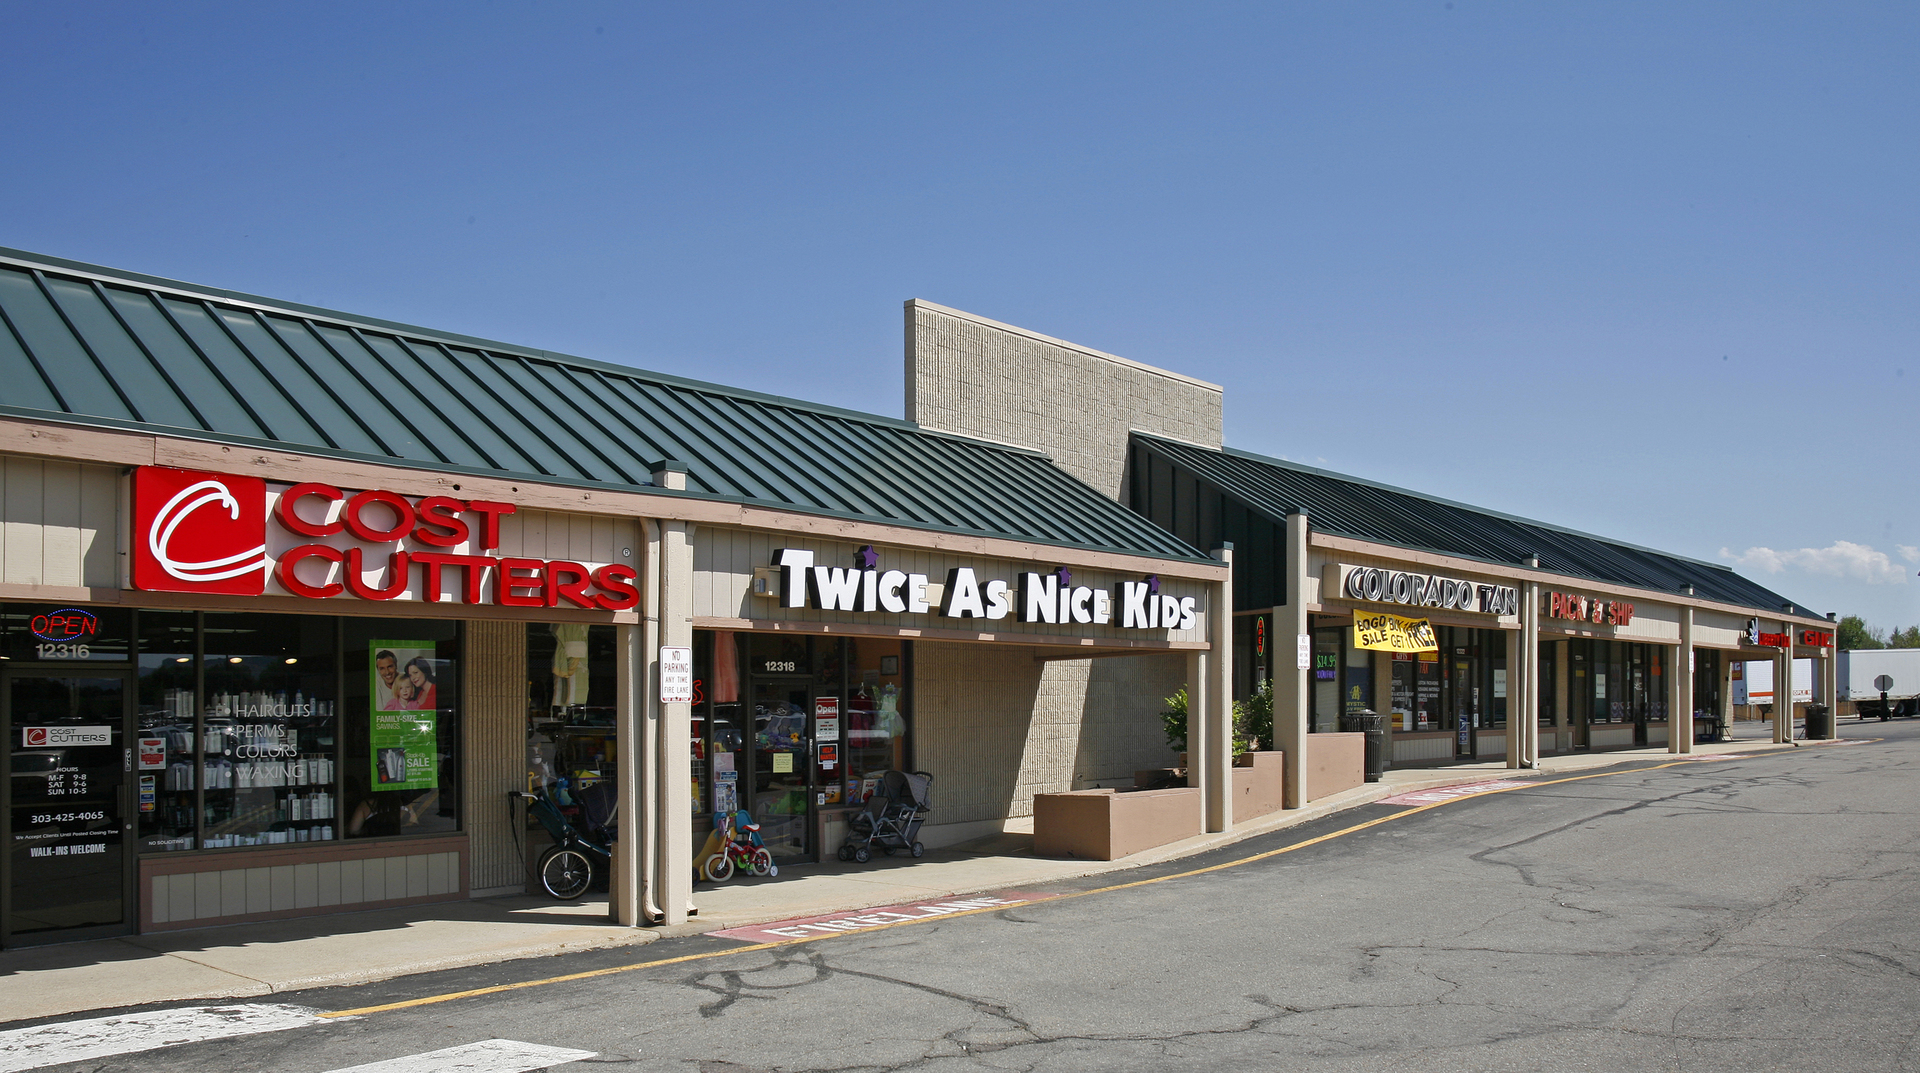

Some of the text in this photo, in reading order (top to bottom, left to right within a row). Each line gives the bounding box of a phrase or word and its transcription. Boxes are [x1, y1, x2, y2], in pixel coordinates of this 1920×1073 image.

[274, 482, 516, 550] COST
[274, 543, 640, 611] CUTTERS
[1346, 567, 1519, 615] COLORADO TAN
[1545, 590, 1635, 627] PACK & SHIP
[31, 615, 98, 635] OPEN
[1357, 615, 1386, 633] BOGO
[1361, 630, 1388, 647] SALE
[1390, 634, 1404, 648] GET
[1407, 622, 1436, 649] FREE
[1802, 630, 1834, 648] GNC
[35, 644, 90, 658] 12316
[671, 650, 681, 661] NO
[664, 662, 689, 674] PARKING
[765, 661, 796, 672] 12318
[664, 676, 688, 684] ANY TIME
[664, 686, 689, 694] FIRE LANE
[235, 704, 311, 718] HAIRCUTS
[816, 704, 836, 715] Open
[236, 724, 285, 738] PERMS
[50, 734, 107, 743] CUTTERS
[235, 743, 298, 759] COLORS
[406, 758, 430, 768] SALE
[49, 774, 65, 782] M-F
[236, 764, 304, 780] WAXING
[47, 787, 87, 796] SUN 10-5
[48, 780, 87, 789] SAT 9-6
[31, 811, 104, 824] 303-425-4065
[30, 843, 106, 858] WALK-INS WELCOME
